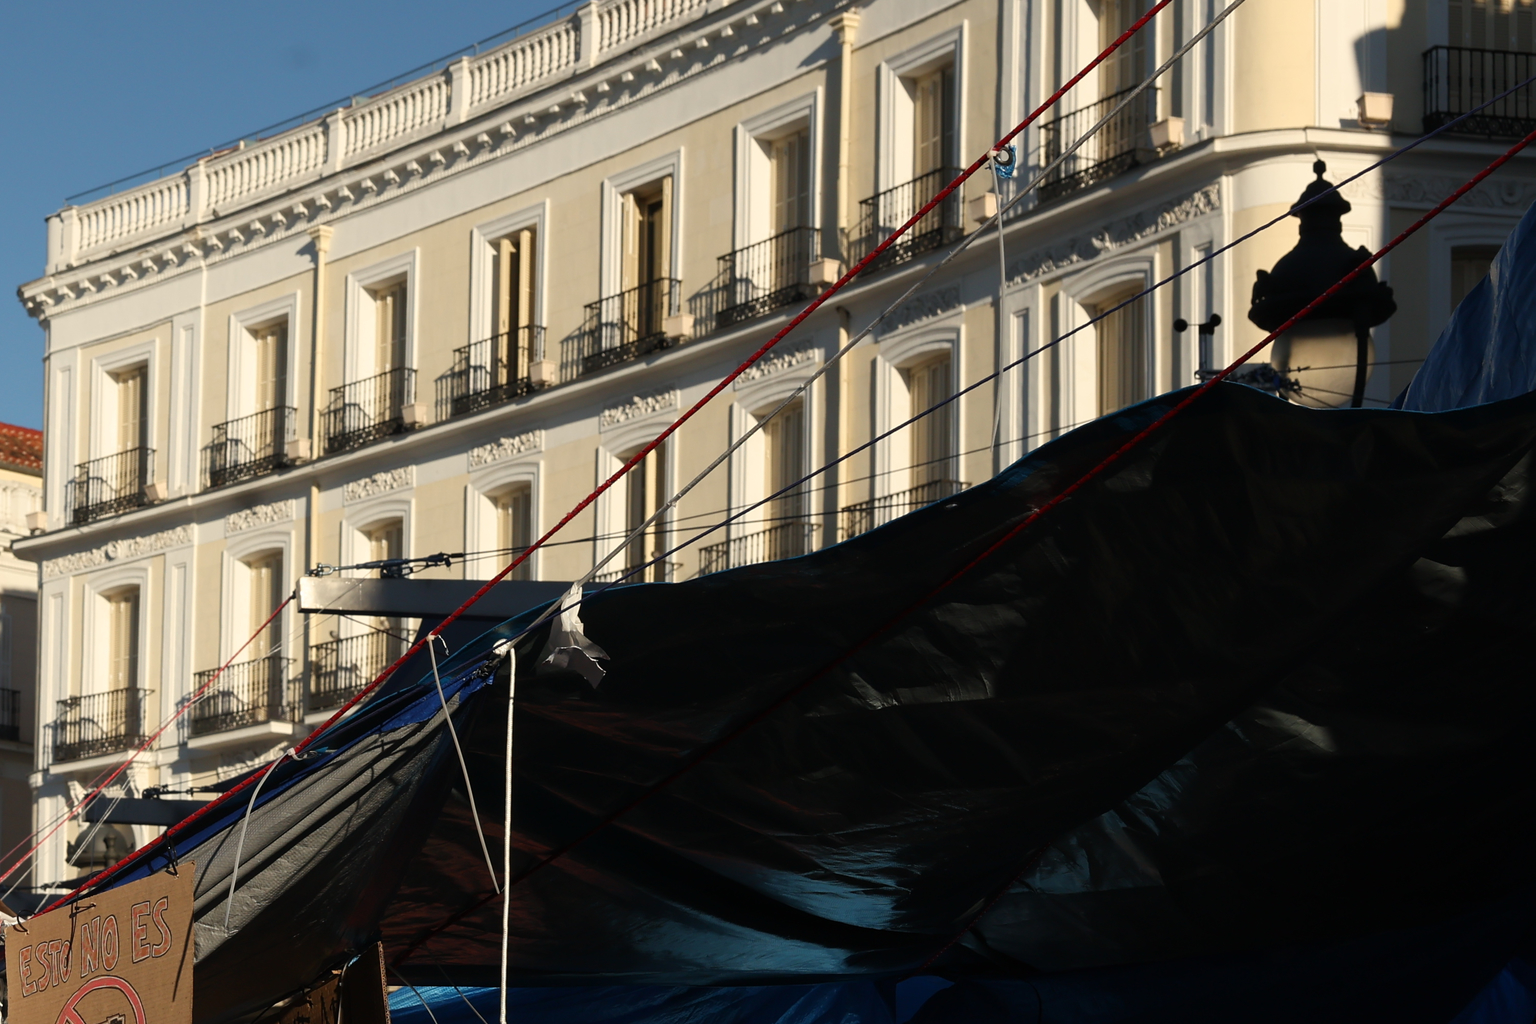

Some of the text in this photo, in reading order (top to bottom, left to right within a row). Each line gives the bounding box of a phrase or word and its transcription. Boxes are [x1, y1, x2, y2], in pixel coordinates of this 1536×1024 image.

[18, 894, 173, 997] ESTO NO ES
